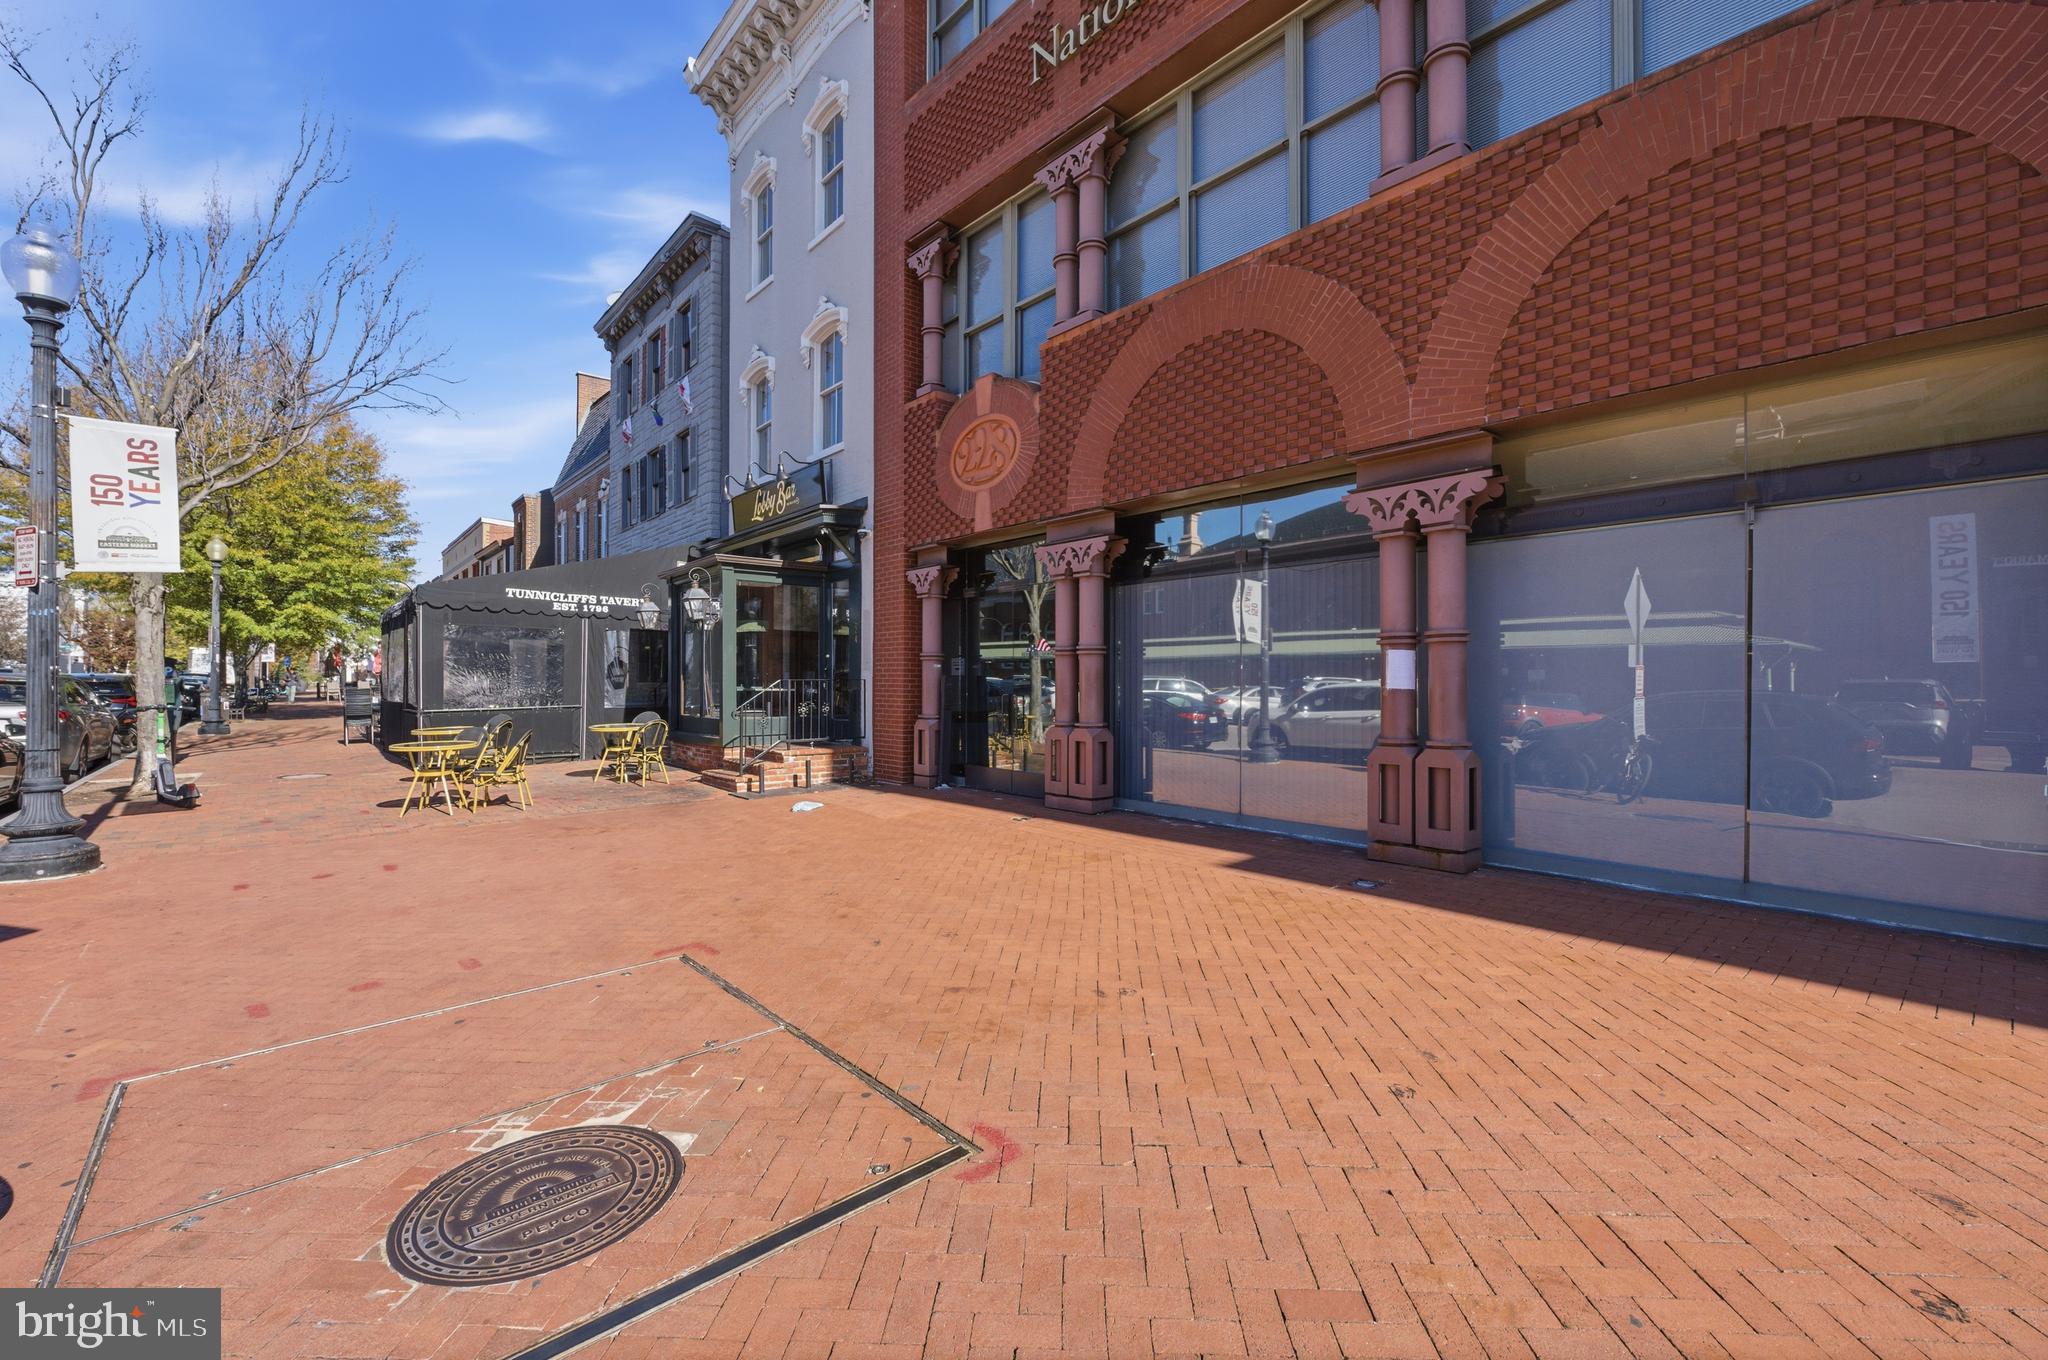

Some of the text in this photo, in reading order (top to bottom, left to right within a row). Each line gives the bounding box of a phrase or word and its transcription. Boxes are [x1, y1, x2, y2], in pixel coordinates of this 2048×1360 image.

[90, 473, 125, 506] 150
[127, 437, 161, 508] YEARS
[751, 480, 797, 522] Lobby Bar
[505, 587, 645, 608] TUNNICLIFFS TAVER
[552, 601, 609, 613] EST. 1796
[475, 1178, 612, 1234] EASTERN MARKET
[519, 1206, 590, 1240] PEPCO
